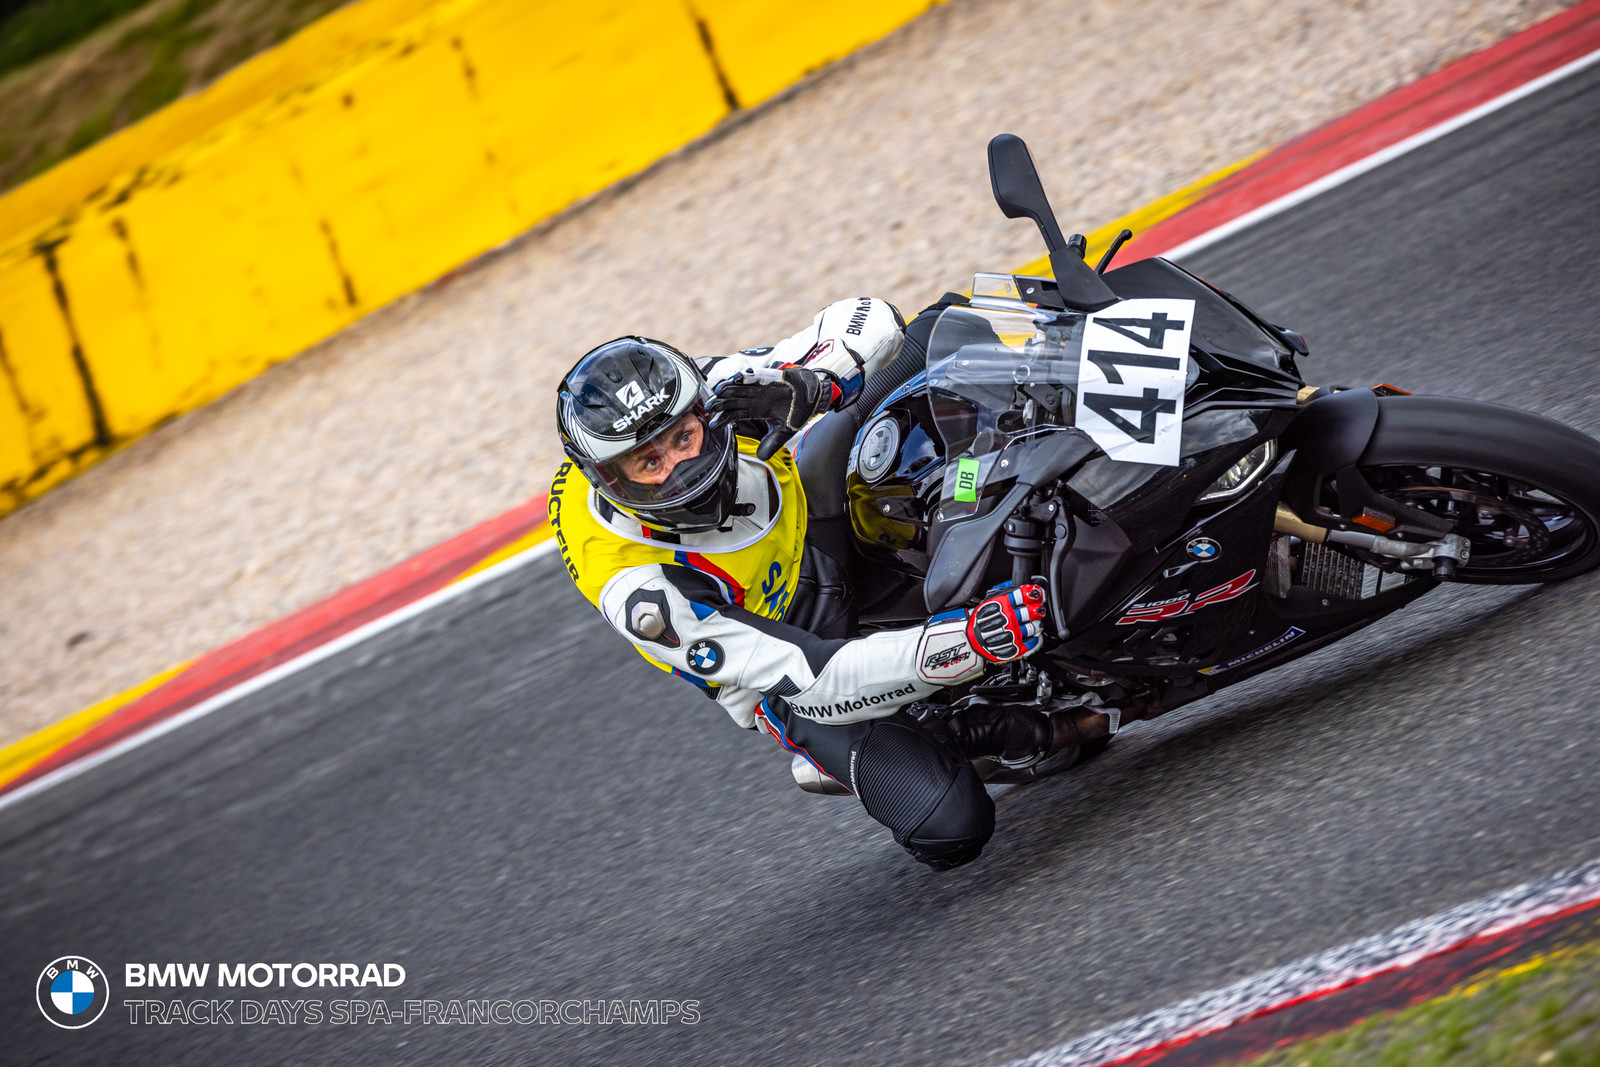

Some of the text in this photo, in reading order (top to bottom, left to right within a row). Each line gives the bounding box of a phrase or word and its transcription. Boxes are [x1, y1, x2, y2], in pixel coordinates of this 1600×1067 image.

[846, 312, 868, 336] BMW
[1083, 312, 1185, 444] 414
[612, 387, 671, 432] SHARK
[959, 471, 974, 491] DB
[1131, 593, 1191, 609] S1000
[924, 642, 967, 668] RST
[1227, 631, 1295, 666] MICHELIN
[790, 683, 916, 718] BMW Motorrad
